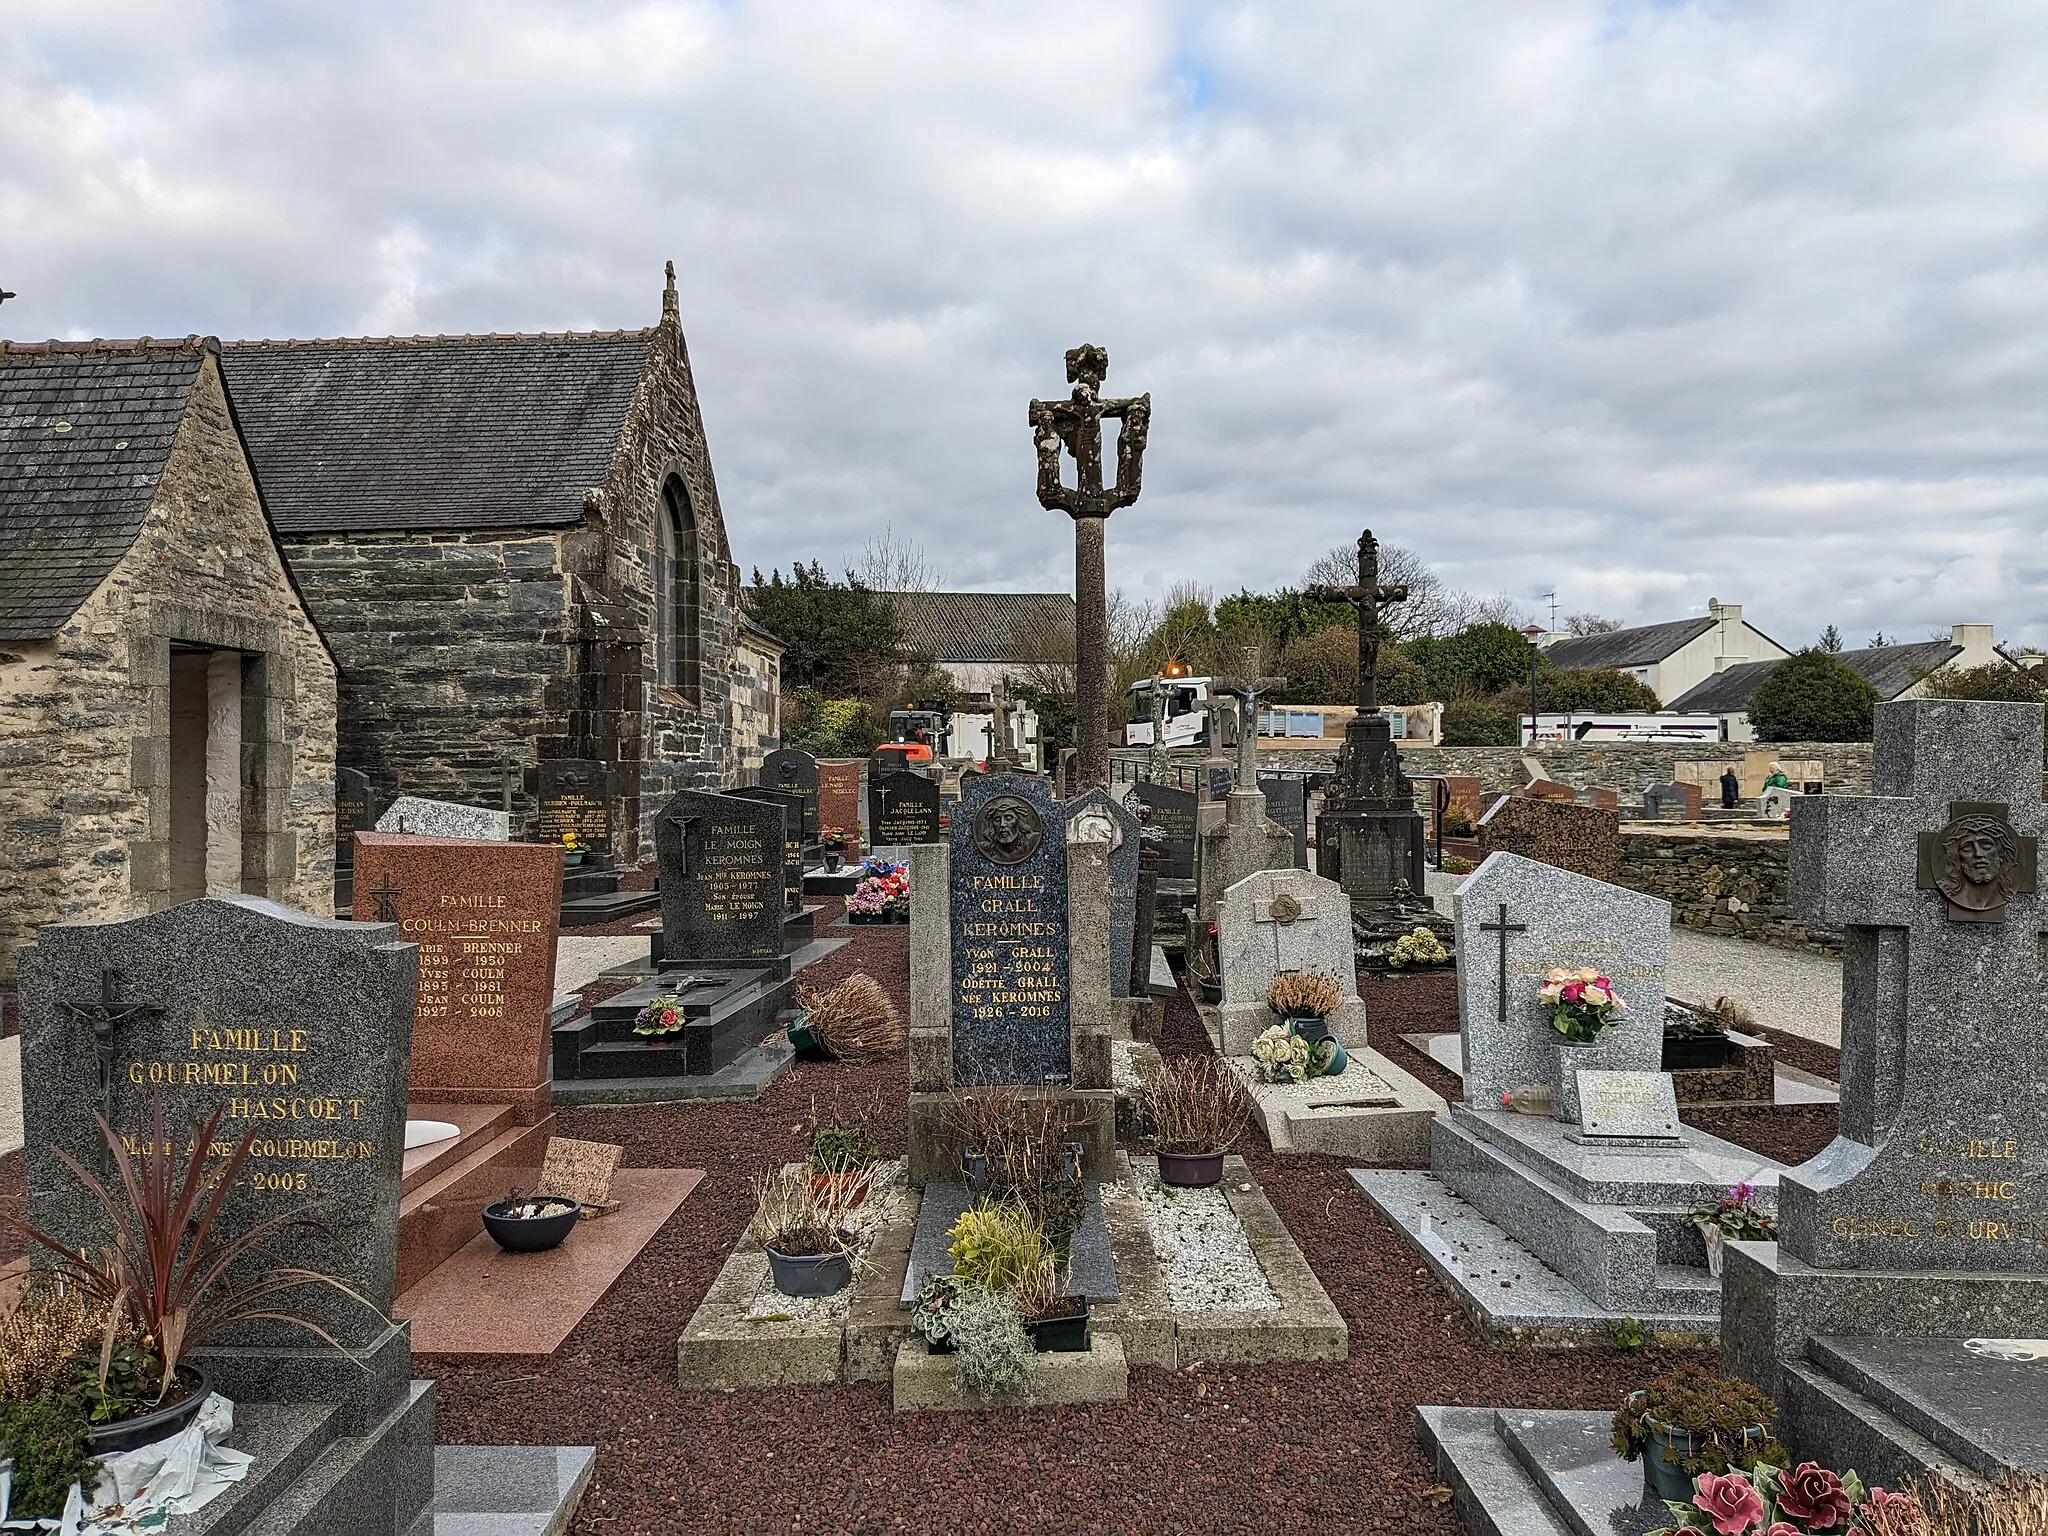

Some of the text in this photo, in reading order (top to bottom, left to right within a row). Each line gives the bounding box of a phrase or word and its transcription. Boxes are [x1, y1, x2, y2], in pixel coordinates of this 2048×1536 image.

[711, 824, 756, 835] FAMILLE
[704, 839, 762, 850] LE MOIGN
[704, 854, 763, 865] KEROMNES
[730, 870, 772, 880] KEROMNES
[709, 882, 730, 891] 1905
[972, 875, 1045, 890] FAMILLE
[440, 895, 508, 909] FAMILLE
[729, 901, 740, 910] LE
[741, 901, 764, 910] MOIGN
[980, 899, 1038, 913] GRALL
[402, 917, 542, 934] COULM-BRENNER
[962, 922, 1056, 937] KEROMNES
[463, 942, 523, 954] BRENNER
[1011, 946, 1054, 959] GRALL
[419, 955, 449, 967] 1899
[474, 955, 505, 967] 1950
[971, 962, 999, 974] 1921
[1014, 961, 1052, 973] 2004
[462, 967, 505, 980] COULM
[474, 981, 502, 993] 1981
[1017, 976, 1061, 988] GRALL
[461, 994, 506, 1005] COULM
[992, 991, 1062, 1003] KEROMNES
[416, 1006, 448, 1018] 1927
[470, 1006, 504, 1019] 2008
[972, 1006, 1004, 1019] 1926
[1020, 1005, 1051, 1018] 2016
[191, 1028, 309, 1053] FAMILLE
[128, 1062, 300, 1086] GOURMELON
[249, 1139, 374, 1159] GOURMELON
[253, 1172, 308, 1191] 2003
